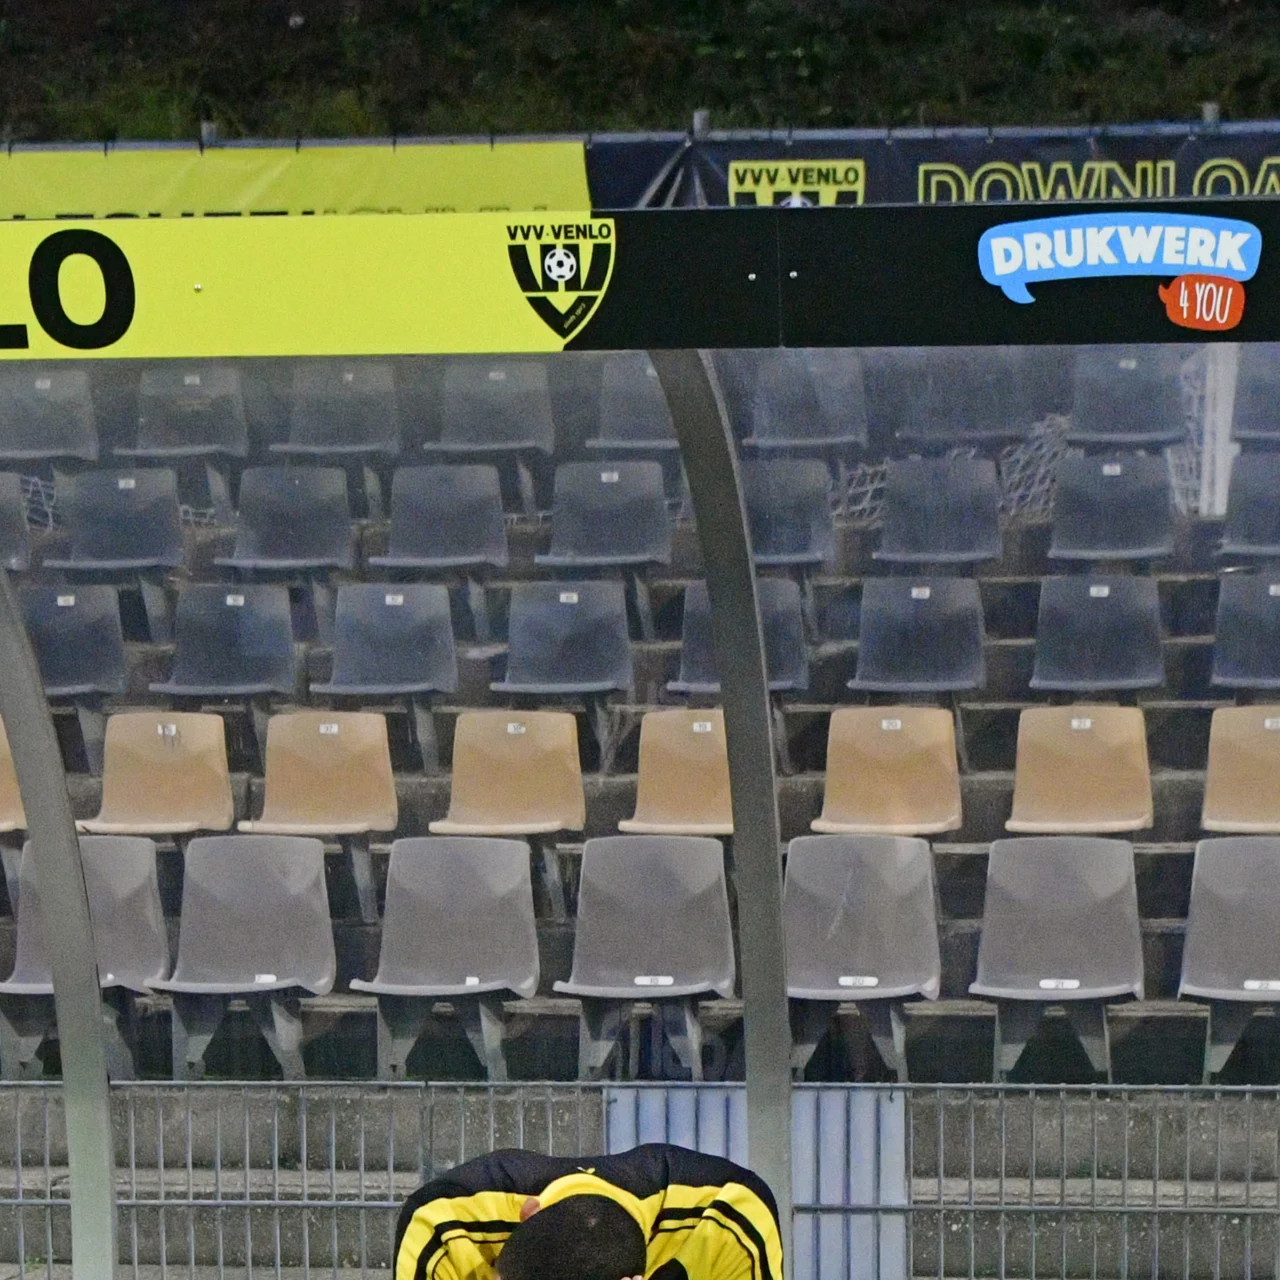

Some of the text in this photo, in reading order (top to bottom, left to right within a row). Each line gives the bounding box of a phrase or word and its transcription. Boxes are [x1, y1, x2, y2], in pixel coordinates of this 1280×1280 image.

[990, 225, 1252, 276] DRUKWERK
[1178, 280, 1234, 325] 4 YOU
